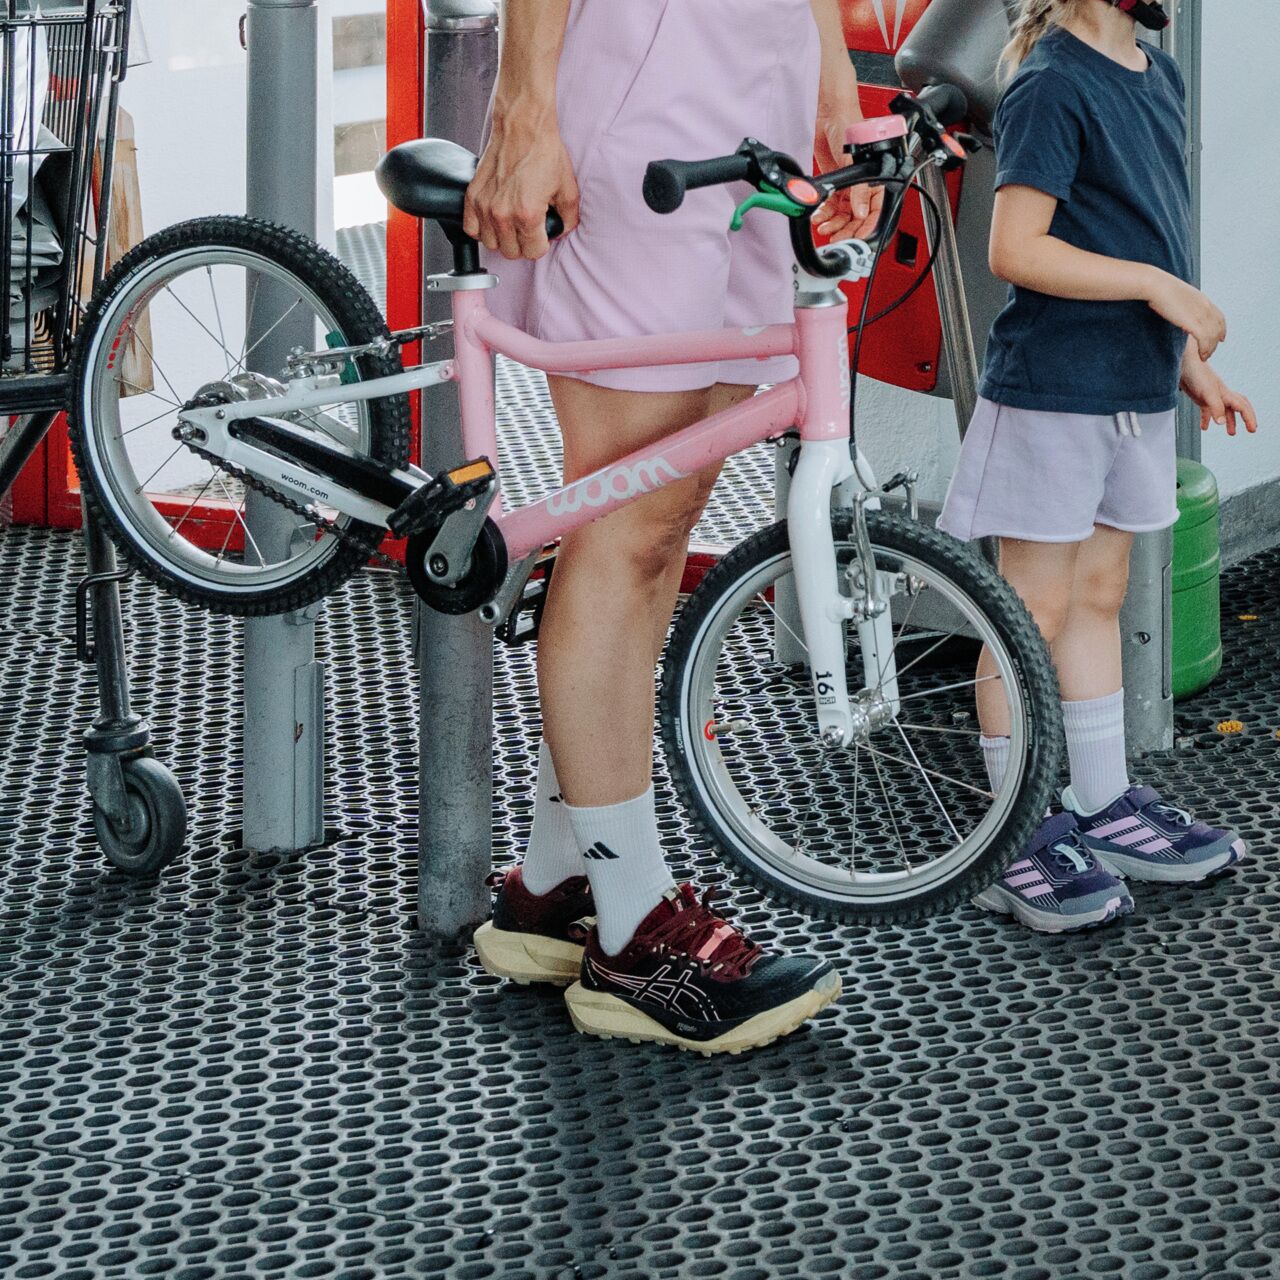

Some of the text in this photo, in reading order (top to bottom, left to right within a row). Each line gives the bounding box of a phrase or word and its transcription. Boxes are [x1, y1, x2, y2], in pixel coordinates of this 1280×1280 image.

[280, 473, 329, 500] woom.com
[546, 456, 686, 517] woom
[815, 671, 835, 696] 16
